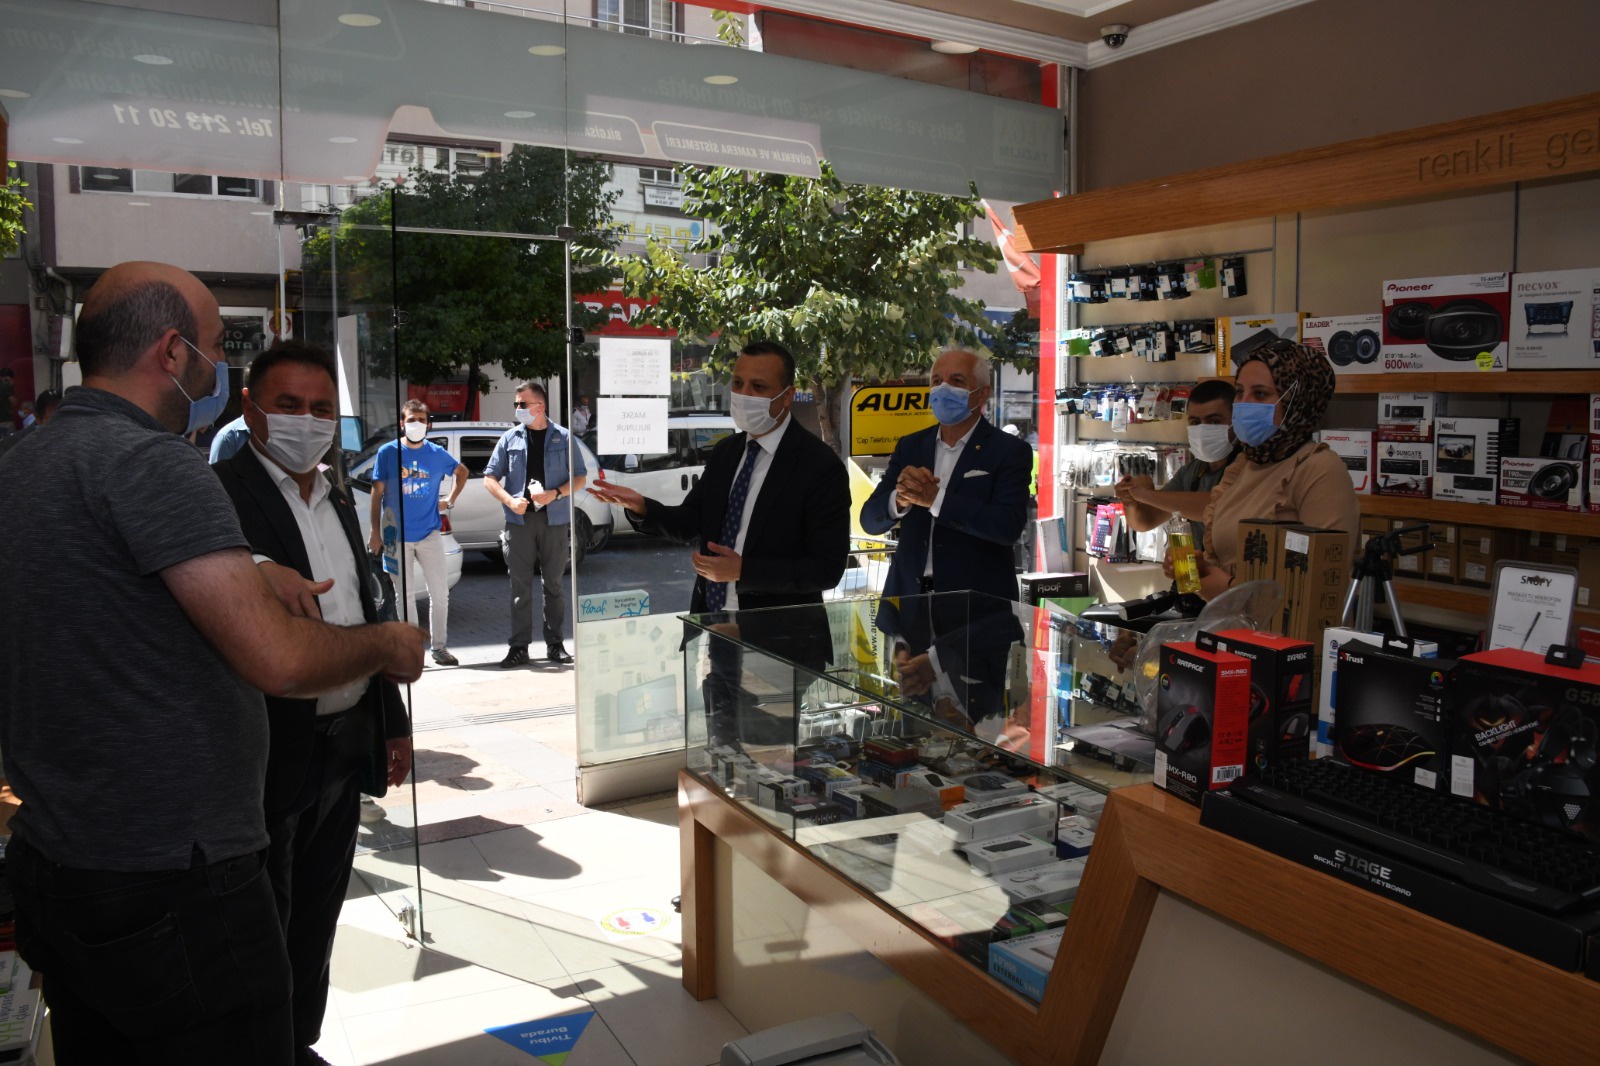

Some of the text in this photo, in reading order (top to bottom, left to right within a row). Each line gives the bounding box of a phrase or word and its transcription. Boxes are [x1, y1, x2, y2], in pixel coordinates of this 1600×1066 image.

[1417, 133, 1514, 181] renkli
[1387, 283, 1434, 293] Pioneer
[1517, 281, 1559, 292] necvox
[1306, 321, 1330, 329] LEADER
[857, 392, 932, 412] AURI
[1502, 460, 1534, 469] Pioneer
[1037, 582, 1061, 593] Roof
[1176, 658, 1204, 673] RAMPAGE
[1346, 653, 1364, 665] Trust
[1474, 719, 1517, 742] BACKLIGHT
[1165, 763, 1197, 784] SMX-R80
[1334, 849, 1392, 880] STAGE
[1313, 854, 1412, 897] BACKLIT GAMING KEYBOARD
[993, 963, 1023, 988] EXTERNAL
[520, 1026, 568, 1038] Burada
[529, 1034, 572, 1045] Tivibu
